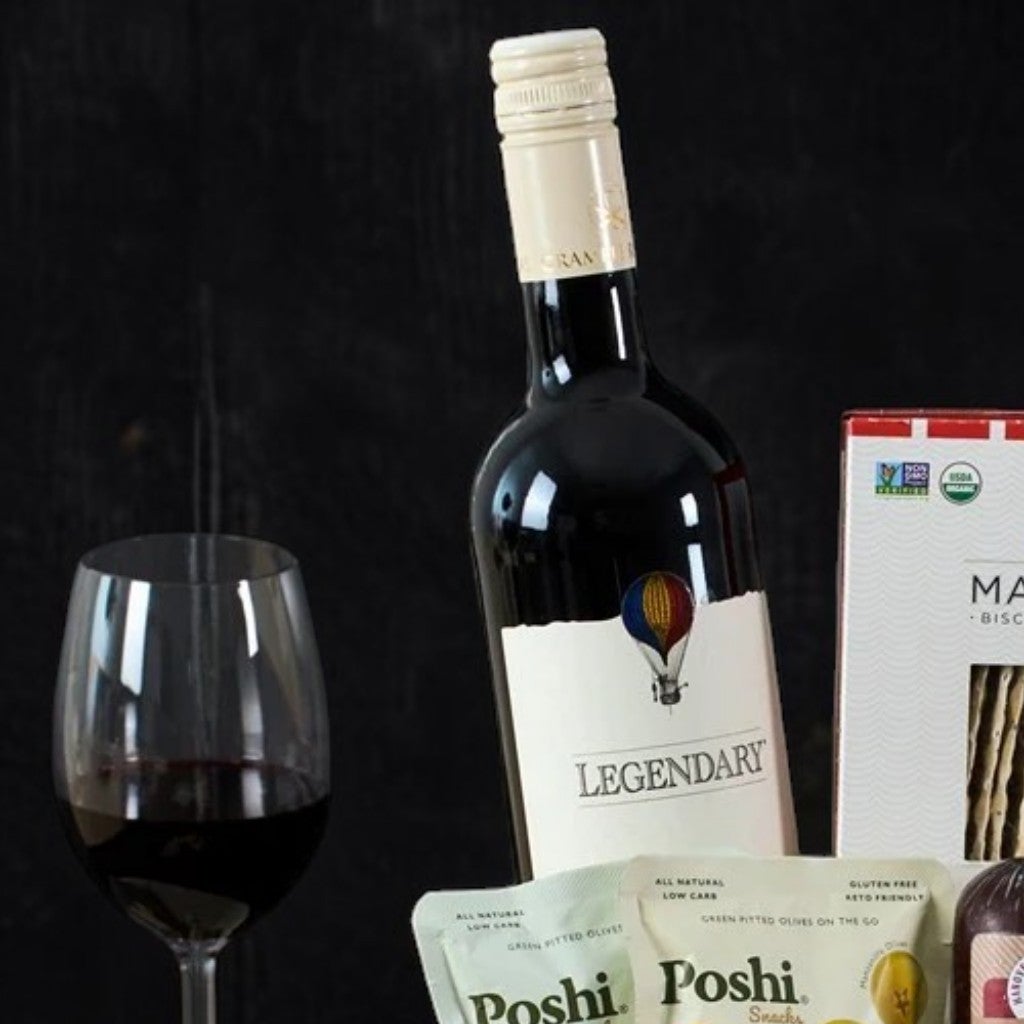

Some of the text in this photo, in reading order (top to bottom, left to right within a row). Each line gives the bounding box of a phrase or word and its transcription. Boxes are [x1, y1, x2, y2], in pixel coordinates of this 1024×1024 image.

[904, 463, 927, 473] NON
[904, 472, 928, 481] GMO
[949, 472, 972, 482] USDA
[576, 740, 766, 798] LEGENDARY
[655, 877, 725, 888] ALL NATURAL
[849, 880, 918, 889] GLUTEN FREE
[662, 892, 718, 901] LOW CARB
[845, 893, 924, 902] KETO FRIENDLY
[456, 909, 525, 921] ALL NATURAL
[701, 914, 880, 927] GREEN PITTED OLIVES ON THE GO
[545, 932, 583, 948] PITTED
[658, 955, 800, 1006] Poshi
